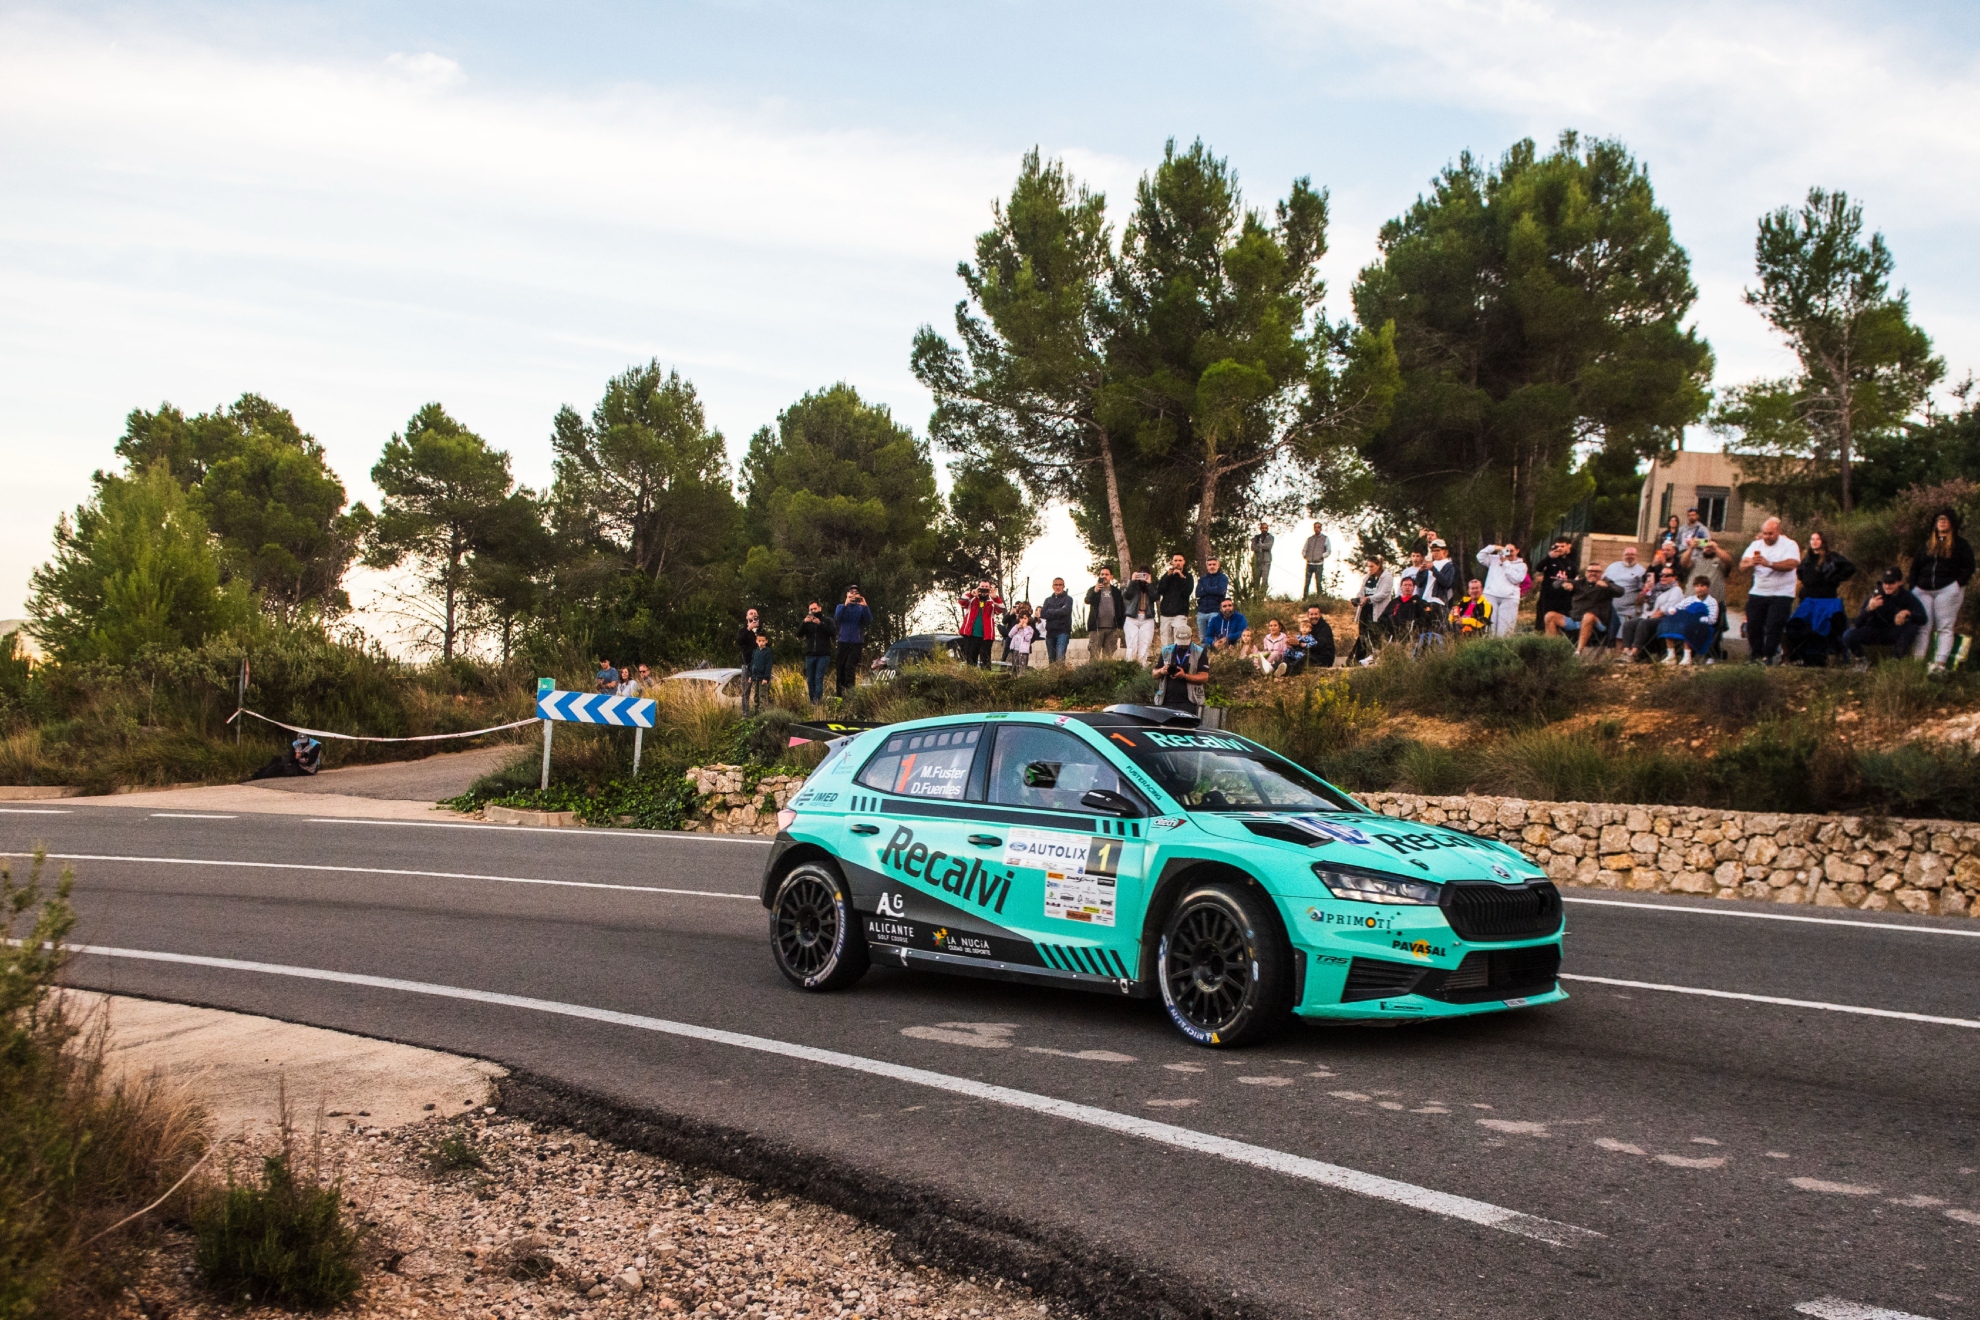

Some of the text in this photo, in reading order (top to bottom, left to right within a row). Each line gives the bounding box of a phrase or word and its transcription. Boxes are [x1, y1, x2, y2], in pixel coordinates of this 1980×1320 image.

[1110, 732, 1137, 747] 1
[1142, 731, 1254, 753] Recalvi
[897, 753, 918, 793] 1
[920, 765, 966, 779] M.Fuster
[910, 782, 961, 796] D.Fuentes
[1126, 765, 1163, 801] FUSTERACING
[812, 792, 839, 802] IMED
[1028, 842, 1087, 860] AUTOLIX
[1098, 843, 1111, 872] 1
[881, 824, 1015, 915] Recalvi
[876, 892, 905, 918] AG
[869, 921, 915, 937] ALICANTE
[1326, 913, 1392, 930] PRIMOTI
[877, 933, 889, 941] GOLF
[946, 936, 957, 945] LA
[1392, 940, 1447, 957] PAVASAL
[1316, 954, 1350, 964] TRS
